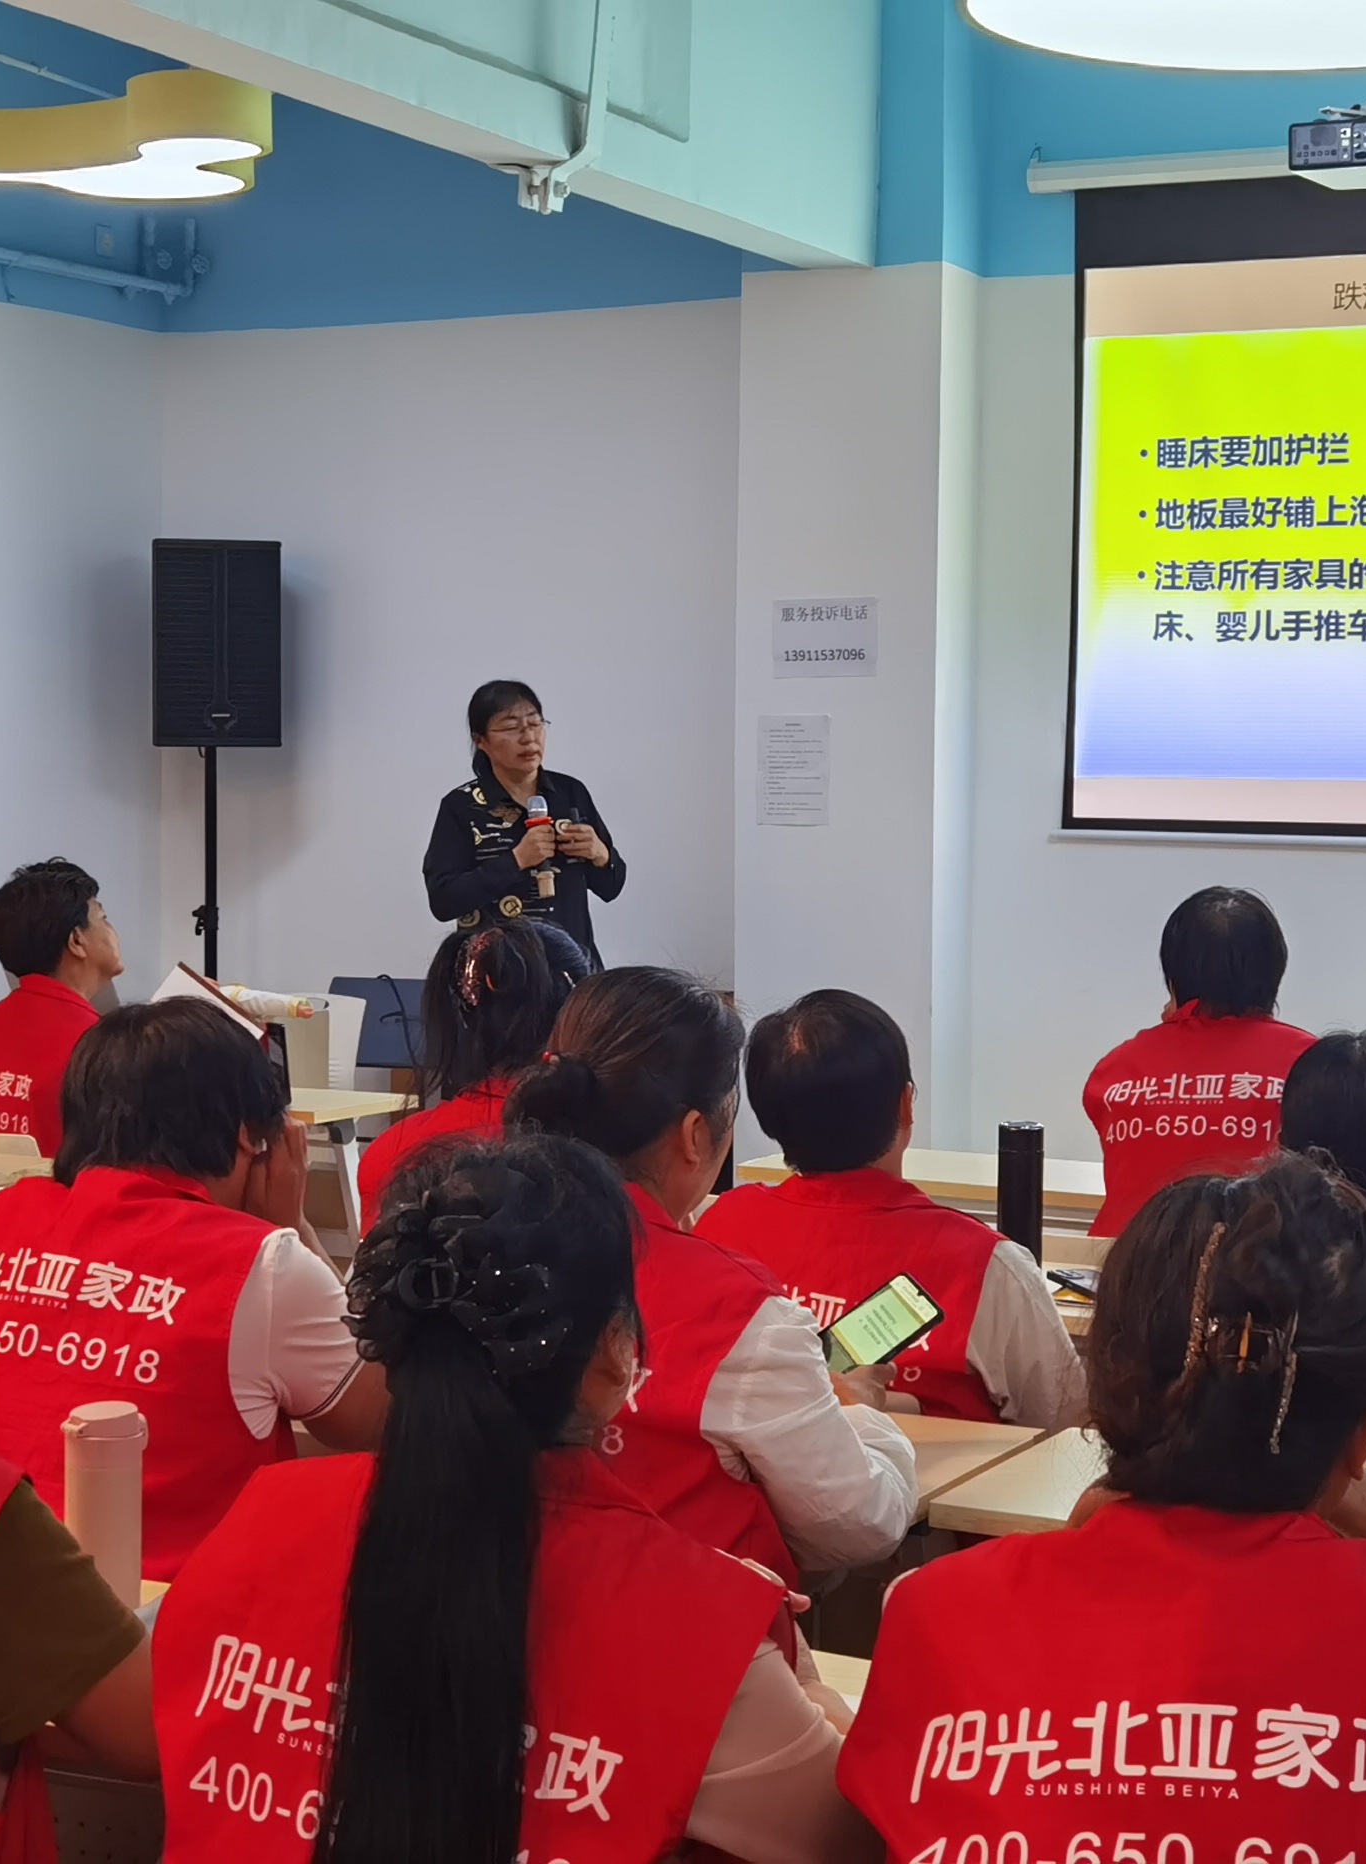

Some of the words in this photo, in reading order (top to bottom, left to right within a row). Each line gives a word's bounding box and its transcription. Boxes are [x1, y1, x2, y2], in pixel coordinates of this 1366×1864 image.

[1156, 432, 1350, 469] 睡床要加护拦
[781, 605, 868, 622] 服务投诉电话
[784, 649, 866, 662] 13911537096
[1025, 1783, 1147, 1797] SUNSHINE
[1165, 1784, 1240, 1800] BEIYA
